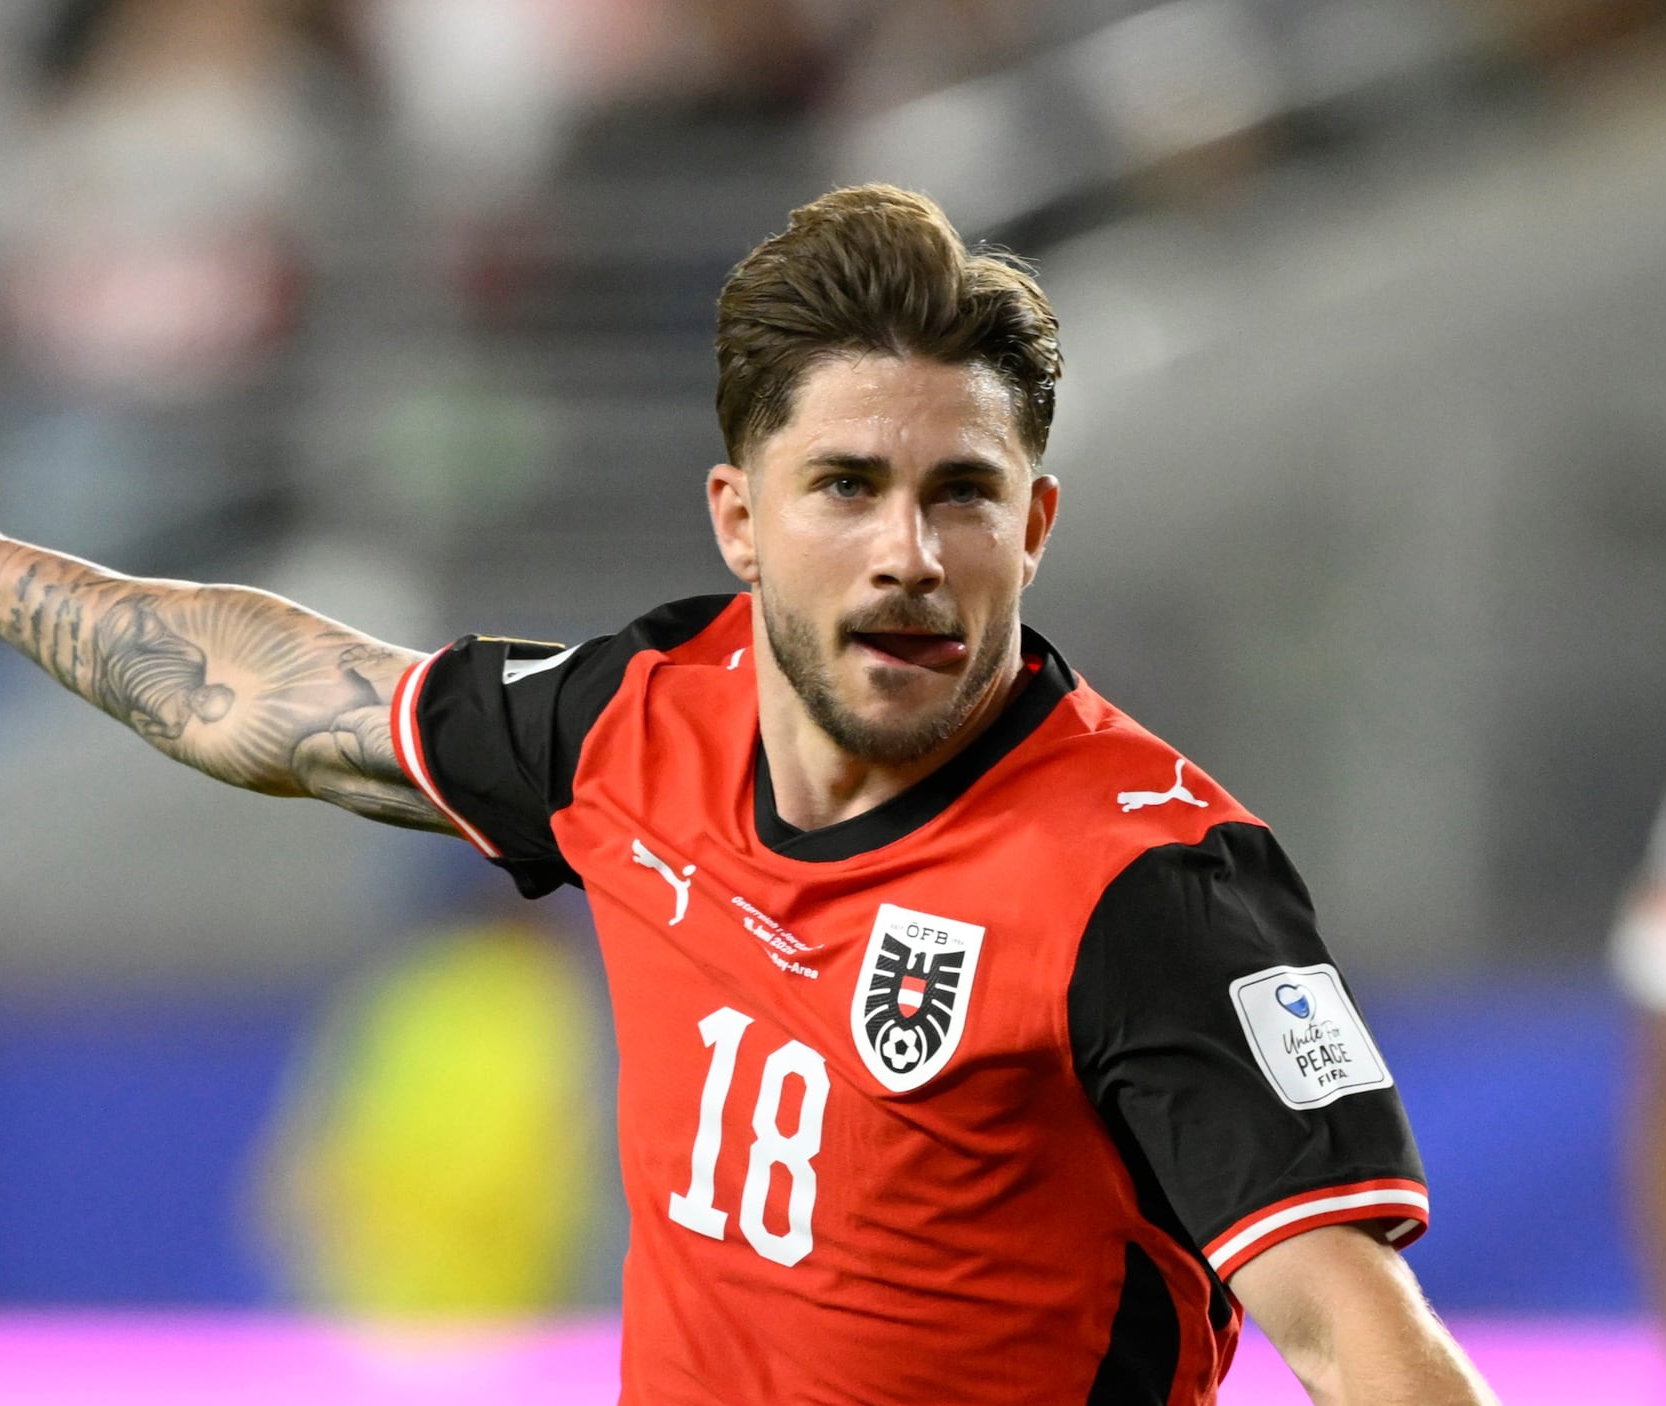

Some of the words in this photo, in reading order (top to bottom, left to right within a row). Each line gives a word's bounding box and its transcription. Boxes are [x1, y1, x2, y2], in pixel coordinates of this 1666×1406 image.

[906, 922, 949, 945] ÖFB
[1283, 1024, 1323, 1055] Unite
[1296, 1043, 1352, 1077] PEACE
[1318, 1069, 1348, 1087] FIFA
[668, 1006, 831, 1267] 18
